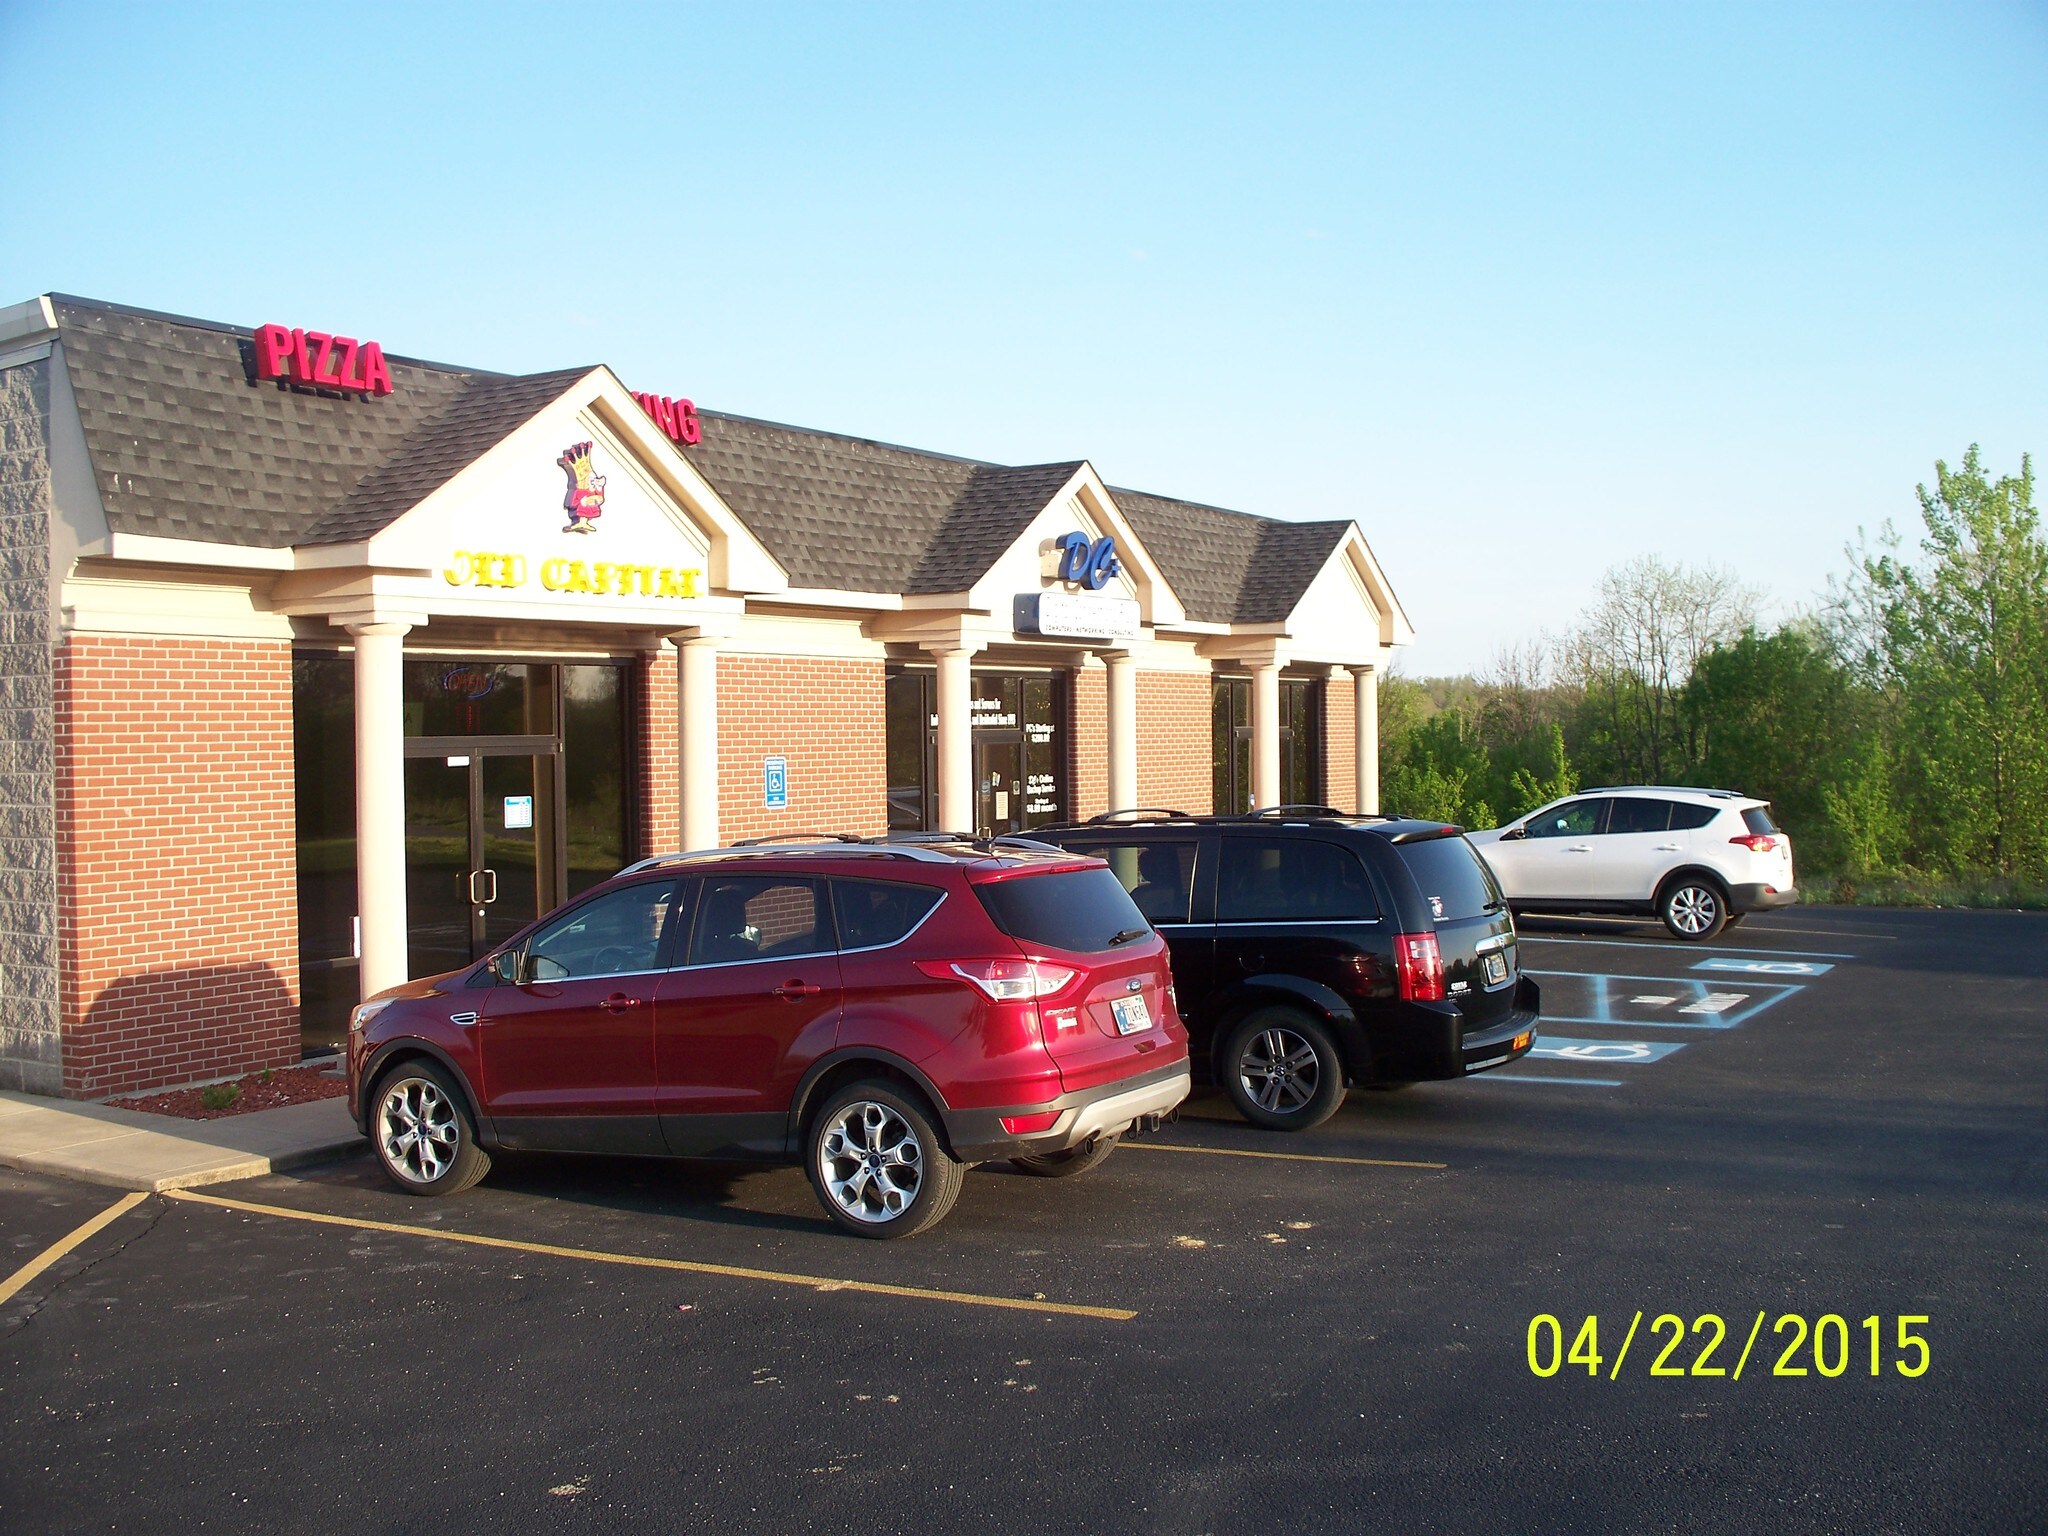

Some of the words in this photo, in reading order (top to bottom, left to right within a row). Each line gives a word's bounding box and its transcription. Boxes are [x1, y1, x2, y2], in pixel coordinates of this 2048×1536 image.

[254, 323, 394, 397] PIZZA
[631, 391, 703, 446] ING
[540, 557, 706, 599] CAPITAL
